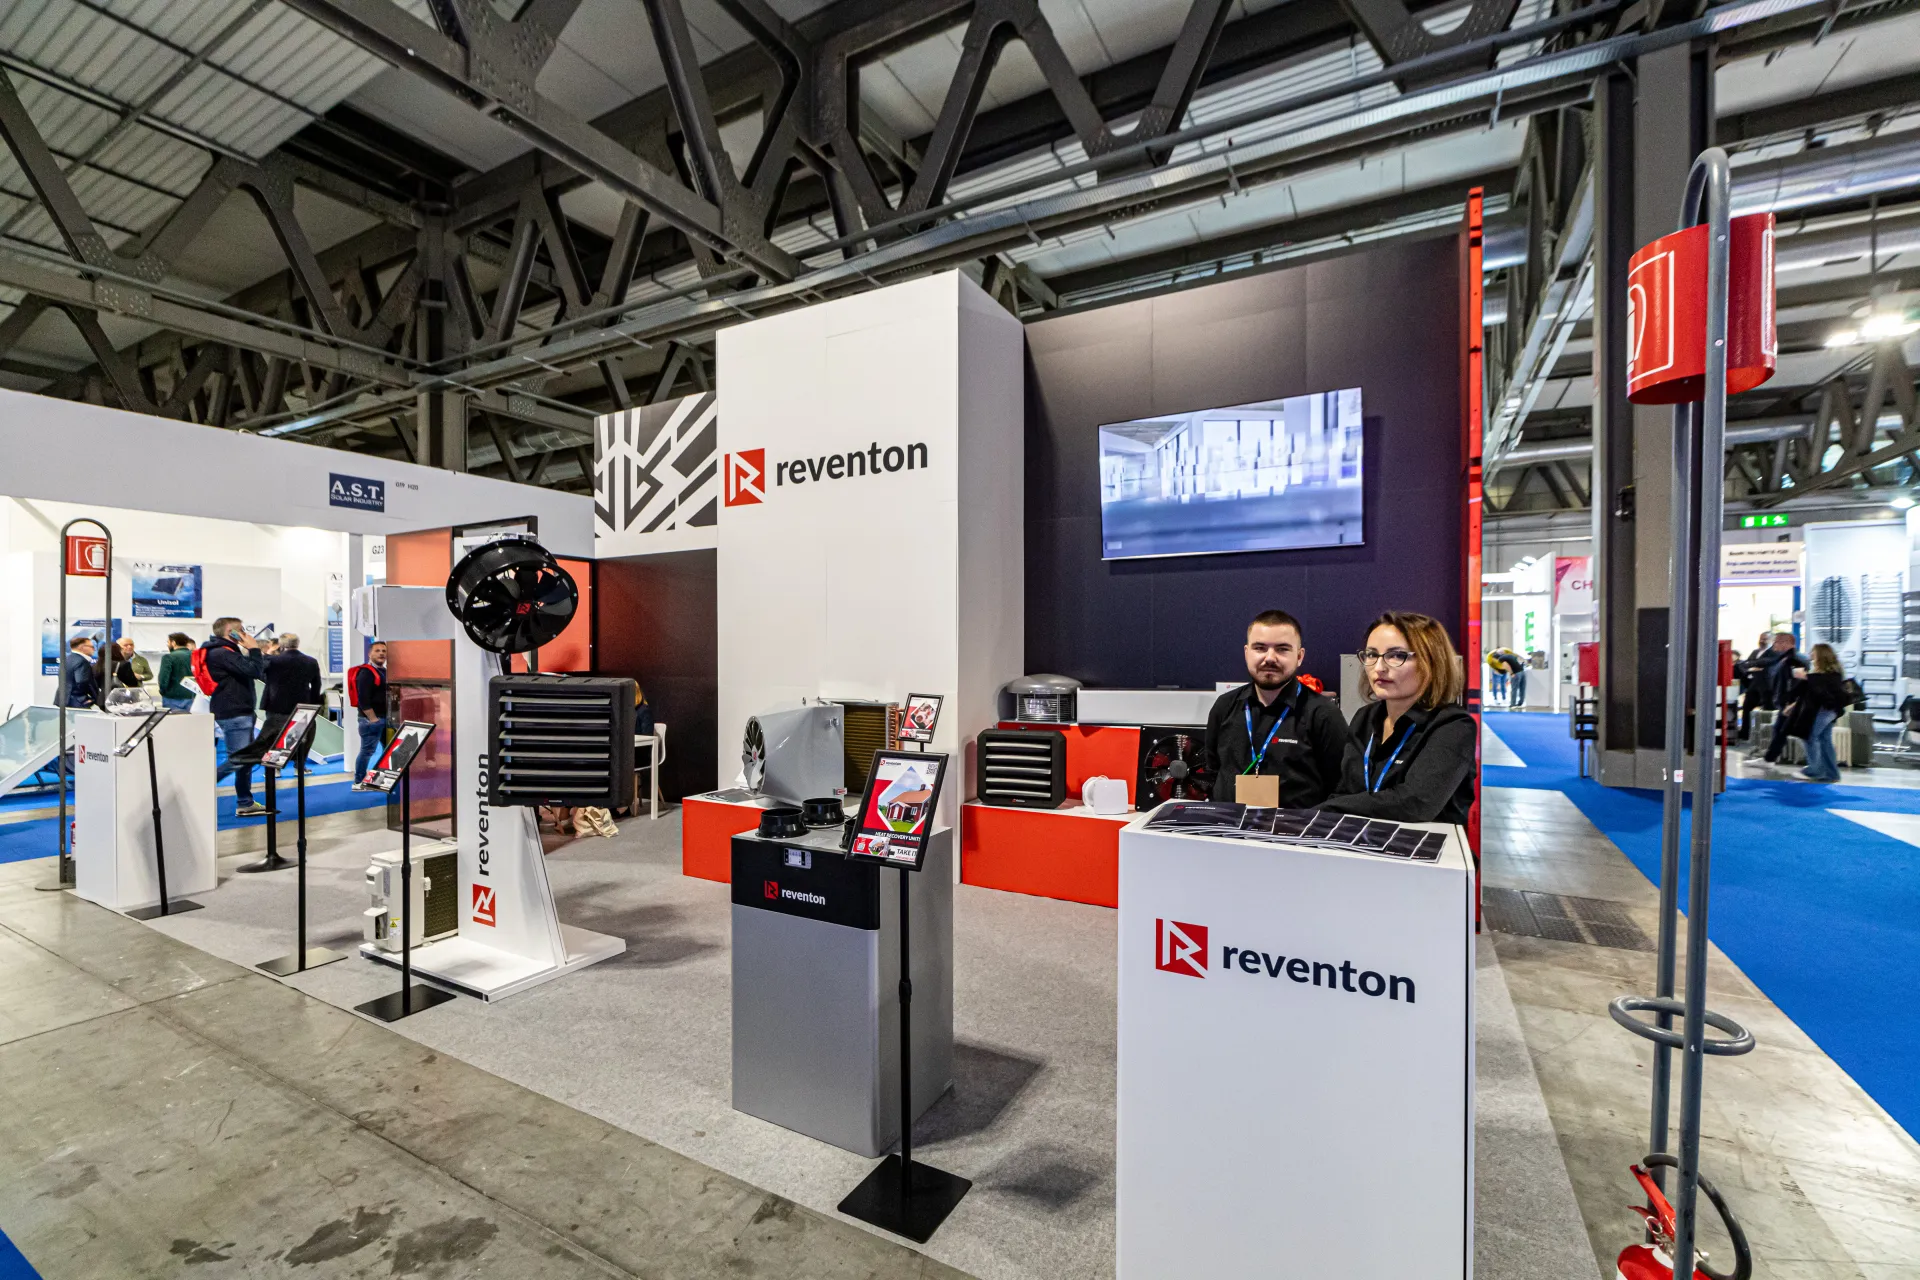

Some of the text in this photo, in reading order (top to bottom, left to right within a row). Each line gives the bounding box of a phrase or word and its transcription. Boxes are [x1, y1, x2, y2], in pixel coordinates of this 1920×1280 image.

[776, 441, 928, 487] reventon
[331, 480, 384, 500] A.S.T.
[330, 493, 383, 507] SOLAR INDUSTRY
[86, 751, 109, 763] reventon
[476, 753, 490, 877] reventon
[896, 848, 911, 857] TAKE
[781, 888, 826, 906] reventon
[1222, 945, 1416, 1004] reventon
